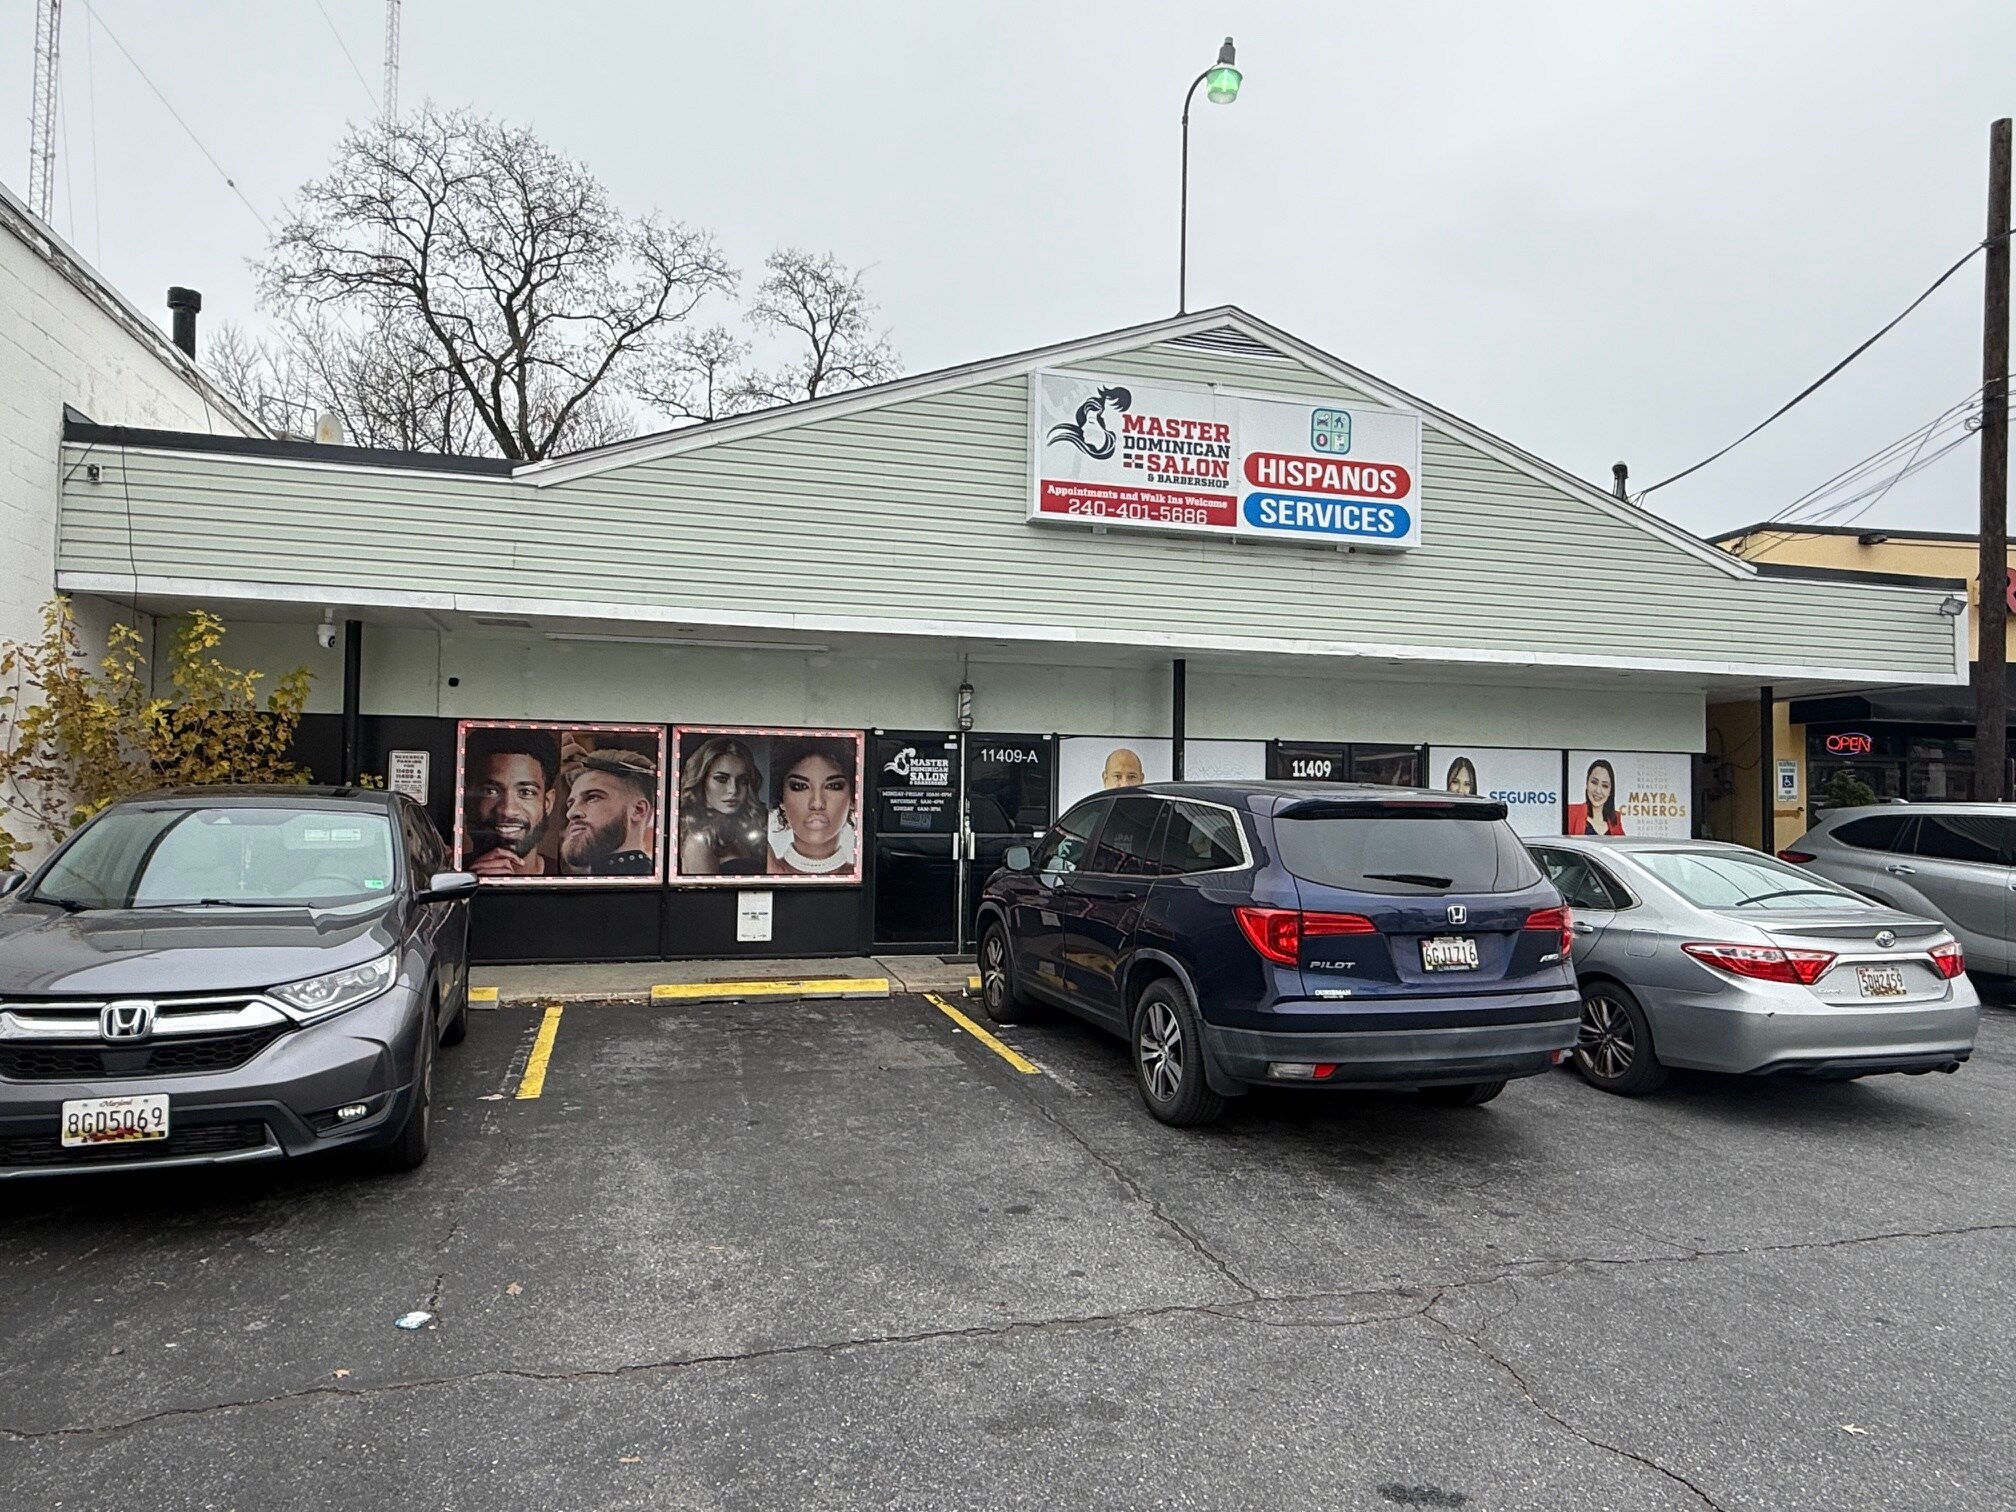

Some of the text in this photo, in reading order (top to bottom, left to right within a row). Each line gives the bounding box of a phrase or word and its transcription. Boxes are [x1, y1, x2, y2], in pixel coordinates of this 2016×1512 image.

[1122, 414, 1230, 443] MASTER
[1123, 435, 1230, 459] DOMINICAN
[1147, 454, 1229, 479] SALON
[1147, 473, 1230, 489] & BARBERSHOP
[1258, 457, 1397, 494] HISPANOS
[1047, 484, 1228, 509] Appointments and Walk Ins Welcome
[1068, 498, 1208, 526] 240-401-5686
[1260, 498, 1395, 533] SERVICES
[1826, 735, 1871, 752] OPEN
[910, 758, 949, 767] MASTER
[981, 748, 1038, 763] 11409-A
[910, 772, 949, 781] SALON
[1292, 760, 1331, 777] 11409
[1489, 791, 1557, 804] SEGUROS
[1629, 792, 1677, 804] MAYRA
[1619, 804, 1686, 817] CISNEROS
[1425, 946, 1477, 964] 6GJ1716
[1309, 961, 1356, 969] PILOT
[99, 1099, 133, 1109] Maryland
[68, 1107, 163, 1134] 8GD5069
